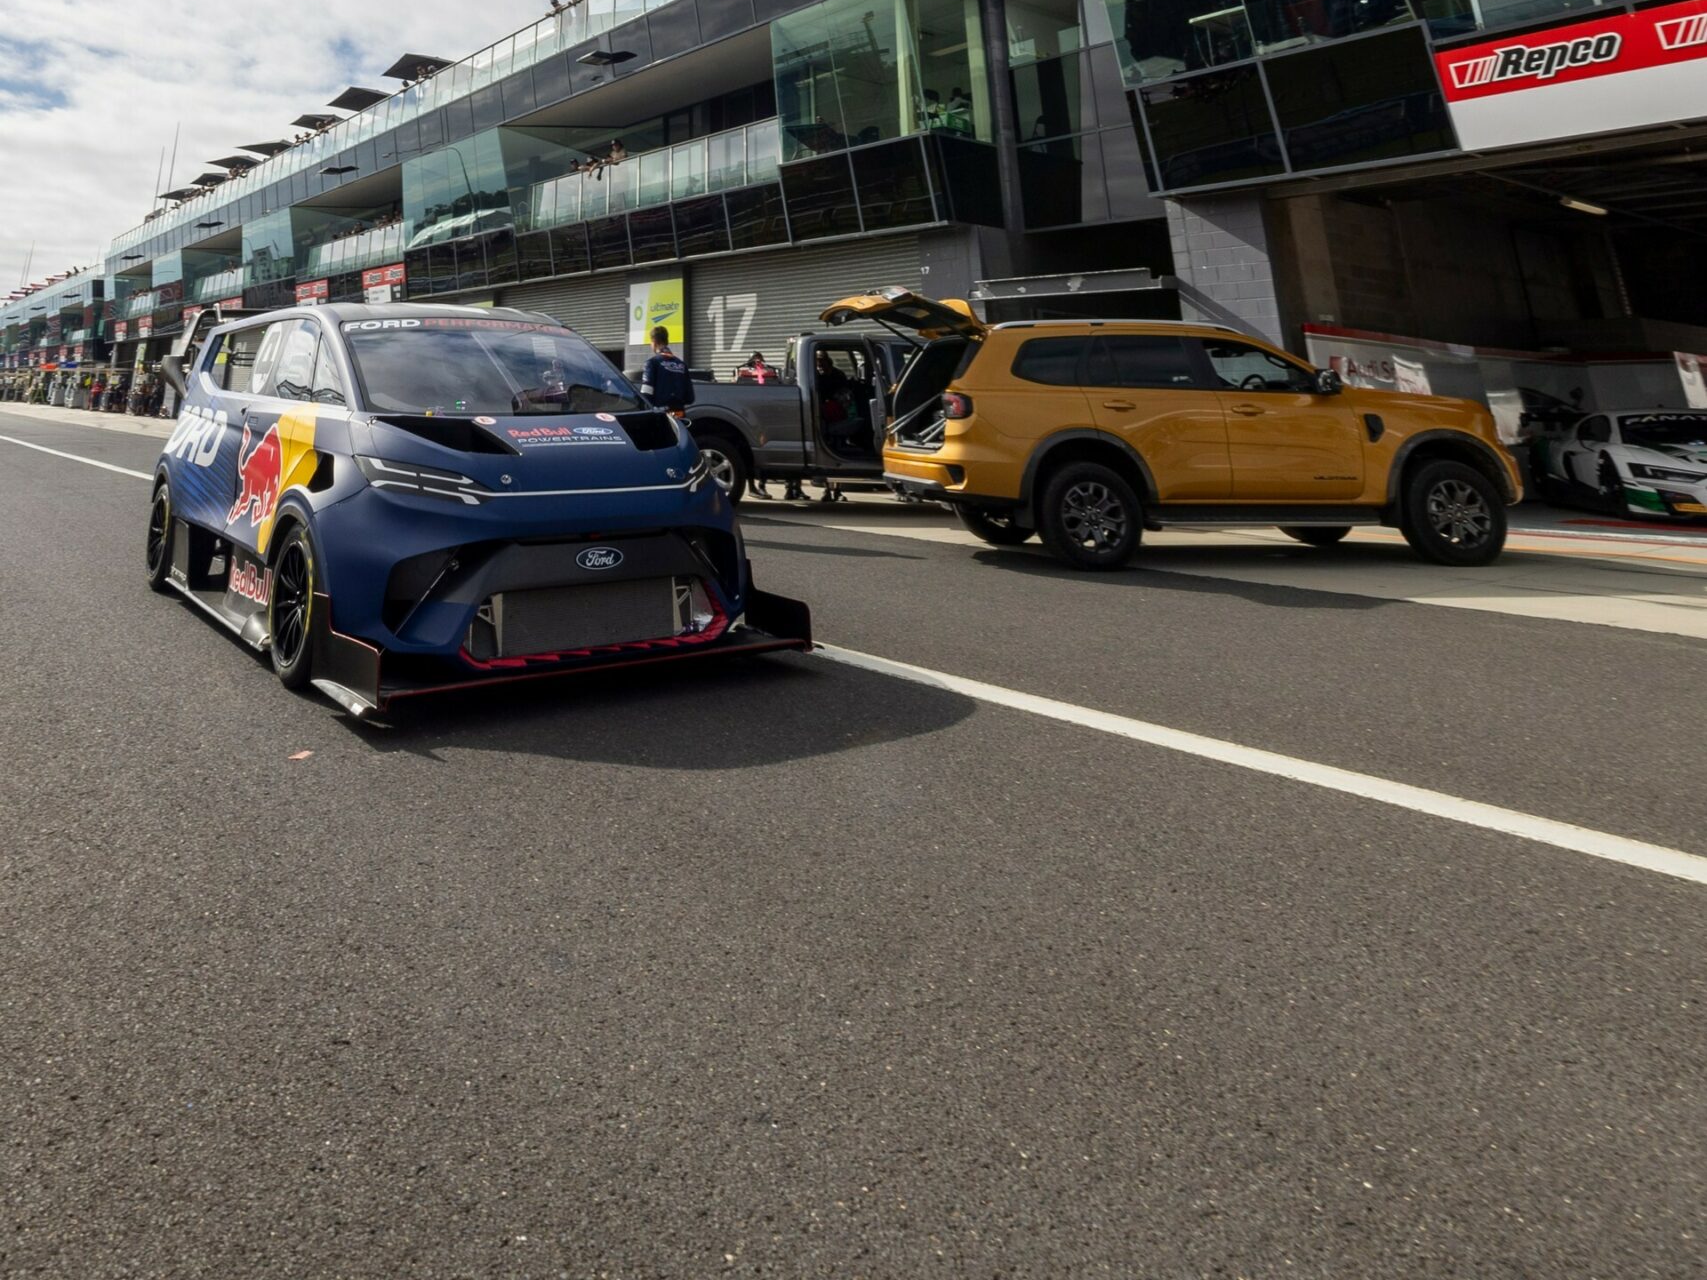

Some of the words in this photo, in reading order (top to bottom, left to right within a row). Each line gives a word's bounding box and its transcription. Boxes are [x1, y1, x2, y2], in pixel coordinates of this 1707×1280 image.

[1492, 32, 1621, 80] Repco
[344, 319, 421, 332] FORD
[706, 292, 757, 352] 17
[517, 435, 623, 444] POWERTRAINS
[584, 549, 616, 567] Ford
